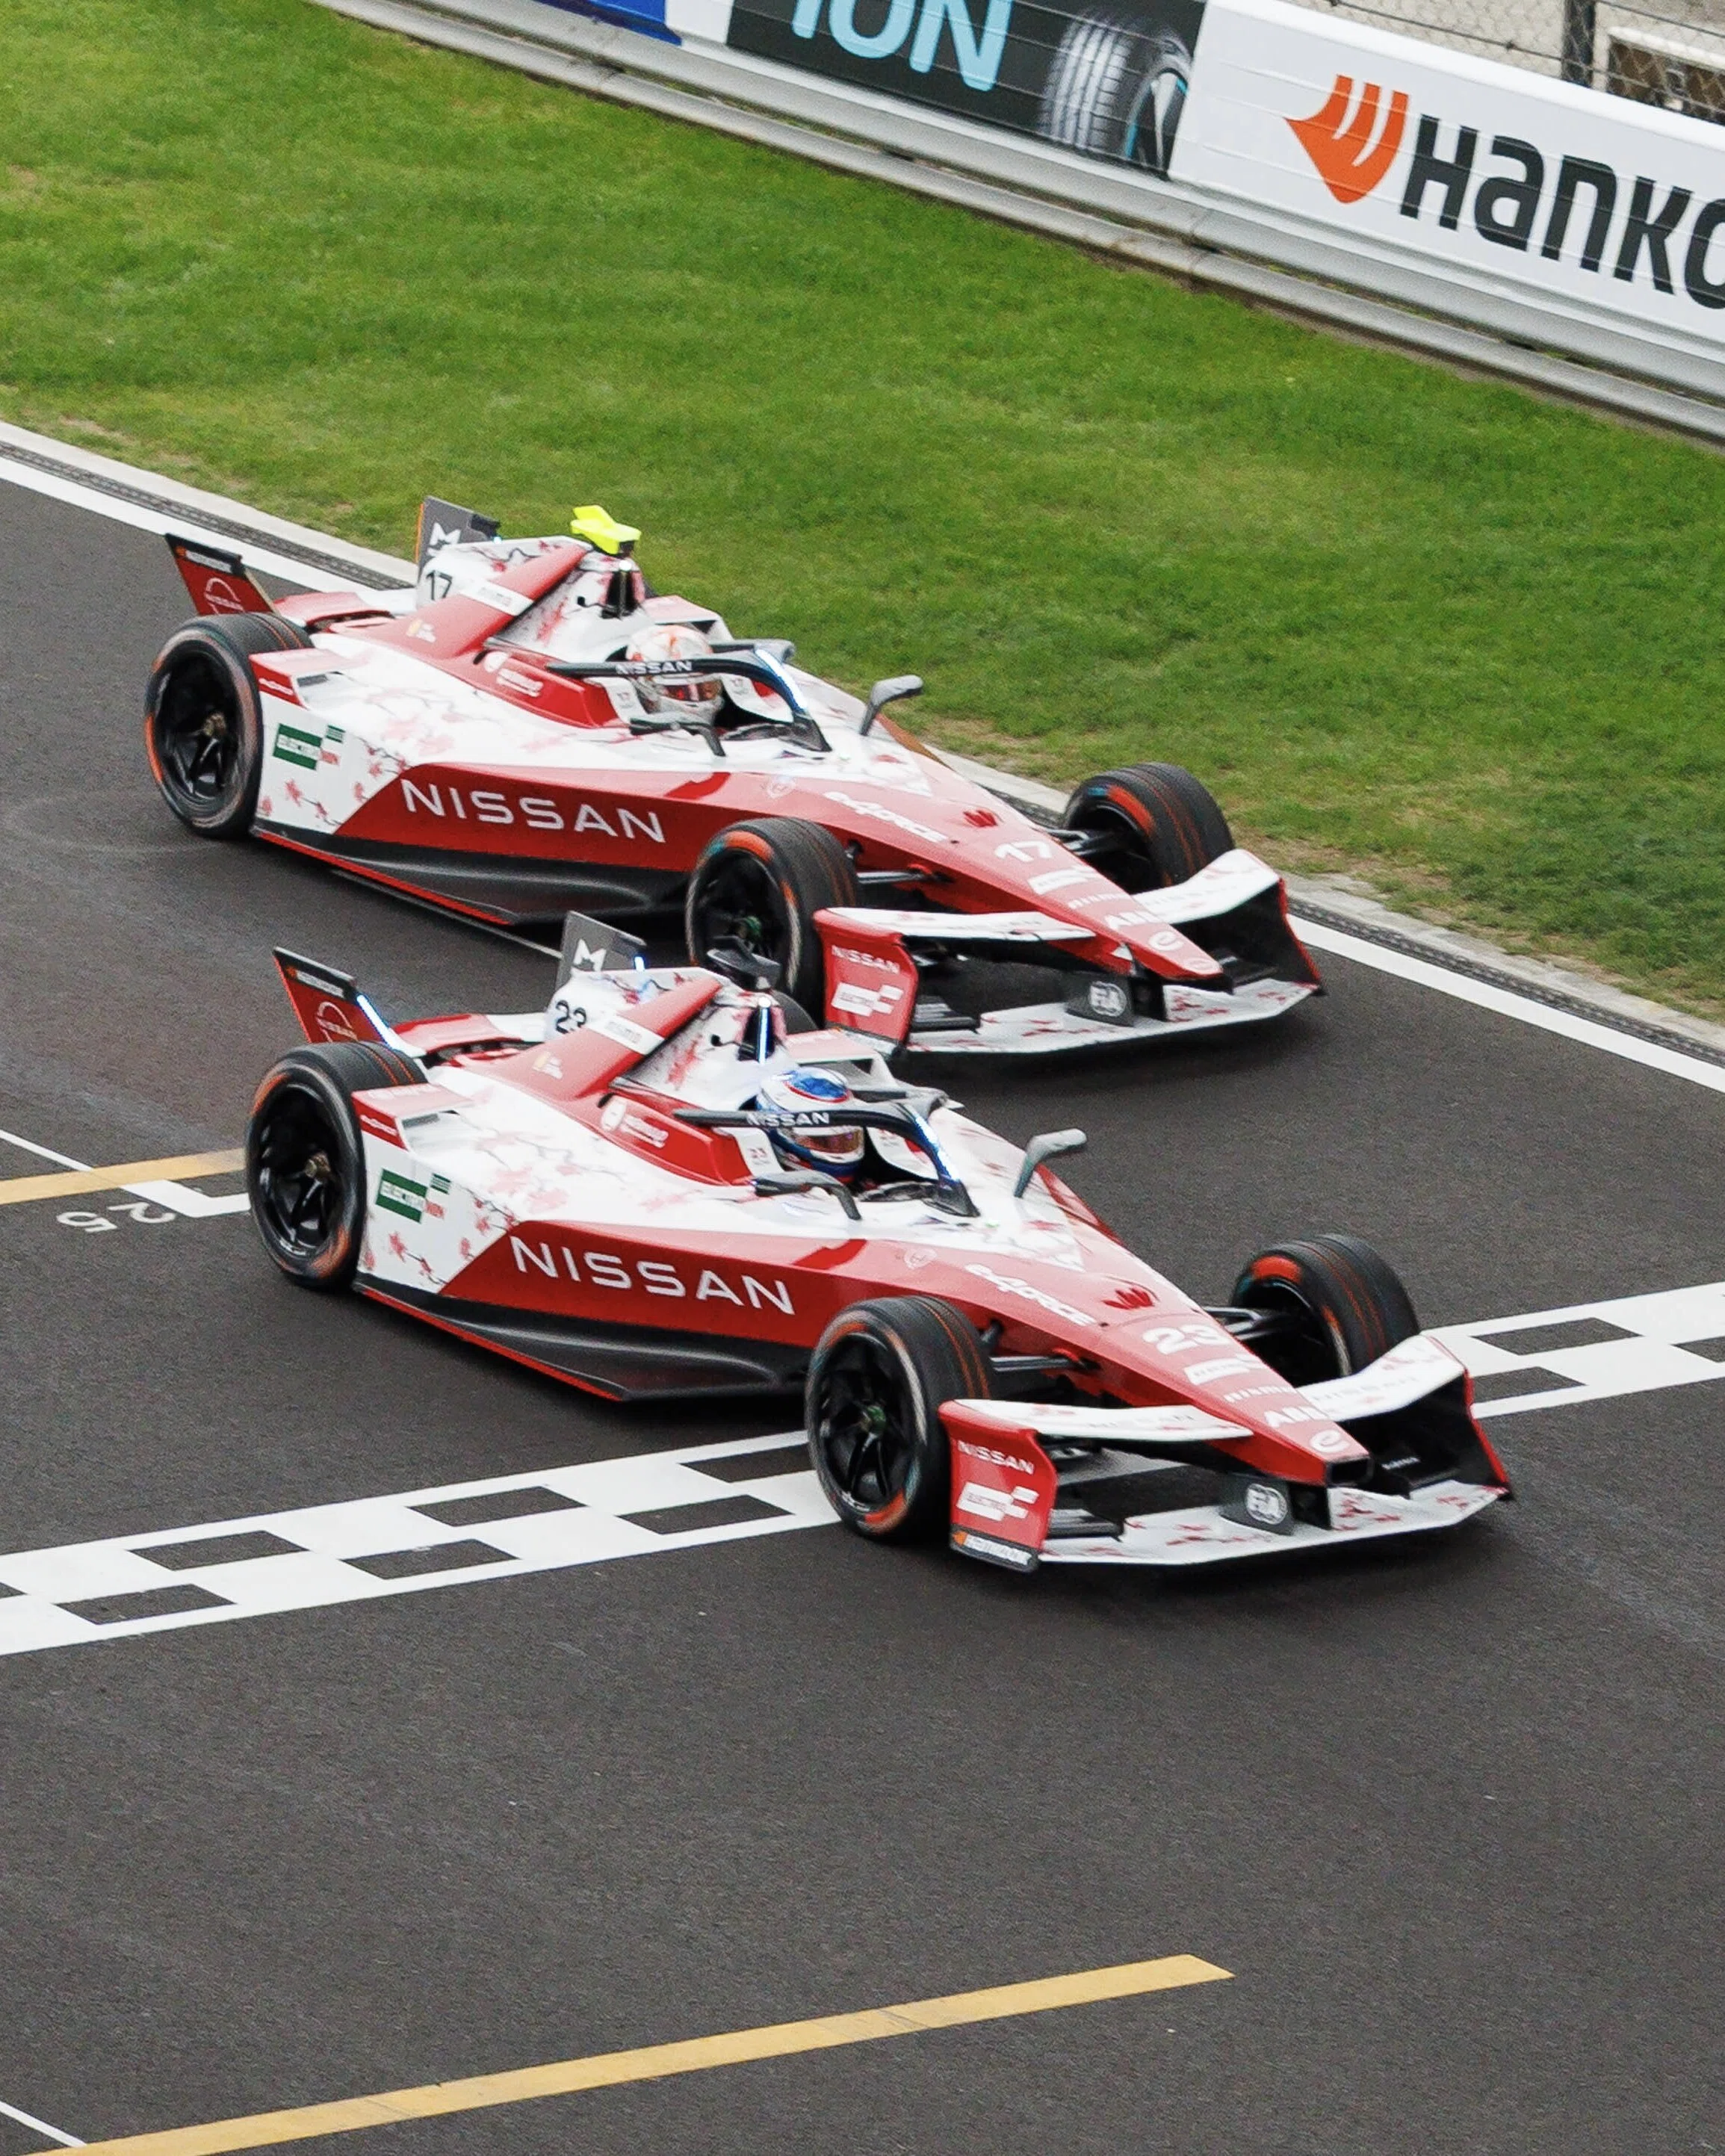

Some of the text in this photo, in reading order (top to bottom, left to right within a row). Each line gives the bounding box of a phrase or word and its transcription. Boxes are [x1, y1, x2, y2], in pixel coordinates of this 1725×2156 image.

[426, 570, 453, 601] 17
[400, 779, 666, 843] NISSAN
[994, 840, 1053, 863] 17
[831, 944, 901, 974] NISSAN
[556, 999, 587, 1034] 23
[510, 1235, 796, 1316] NISSAN
[1142, 1324, 1232, 1355] 23
[957, 1440, 1035, 1475] NISSAN
